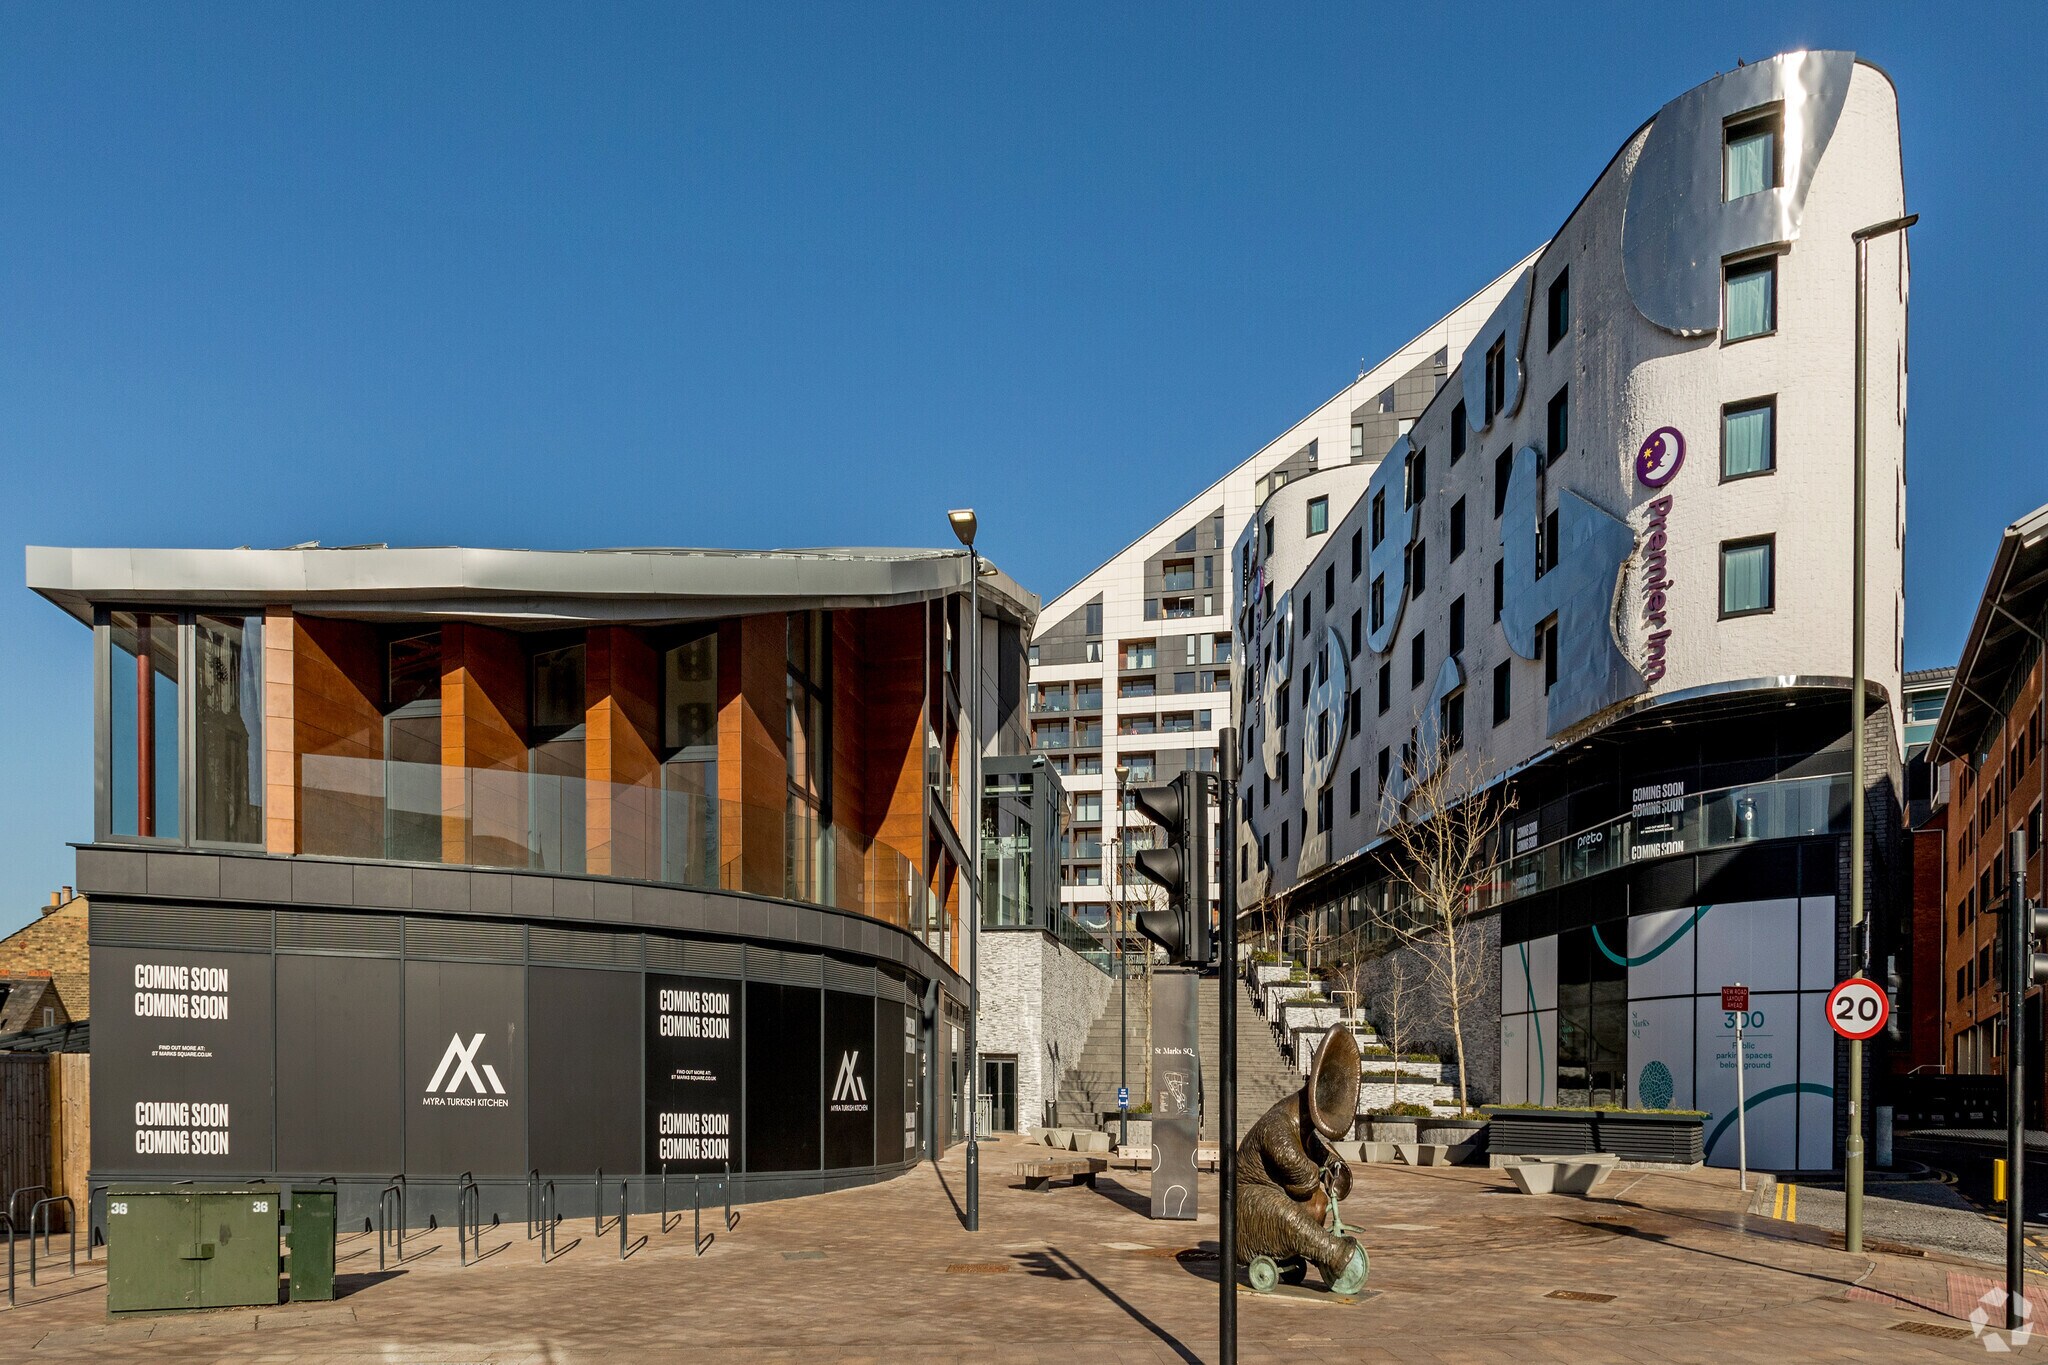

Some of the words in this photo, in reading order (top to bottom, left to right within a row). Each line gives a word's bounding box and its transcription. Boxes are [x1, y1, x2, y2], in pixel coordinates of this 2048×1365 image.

[1648, 494, 1674, 627] Premier
[1648, 628, 1672, 682] Inn
[1632, 784, 1661, 802] COMING
[1662, 781, 1684, 798] SOON
[1632, 801, 1661, 818] COMING
[1661, 797, 1684, 814] SOON
[1631, 843, 1661, 860] COMING
[1661, 840, 1684, 856] SOON
[135, 964, 189, 990] COMING
[190, 967, 229, 992] SOON
[135, 992, 189, 1018] COMING
[190, 995, 229, 1020] SOON
[660, 989, 700, 1013] COMING
[701, 992, 730, 1015] SOON
[1836, 996, 1878, 1021] 20
[660, 1014, 700, 1038] COMING
[701, 1017, 730, 1039] SOON
[1724, 1011, 1765, 1028] 300
[1163, 1046, 1182, 1055] Marks
[1182, 1047, 1196, 1058] SQ
[1731, 1041, 1756, 1050] Pblic
[1719, 1061, 1739, 1069] belo
[1744, 1061, 1771, 1070] ground
[1745, 1053, 1773, 1061] spaces
[422, 1097, 446, 1106] MYRA
[447, 1098, 476, 1106] TURKISH
[477, 1098, 509, 1107] KITCHEN
[135, 1101, 189, 1126] COMING
[191, 1103, 229, 1127] SOON
[659, 1112, 700, 1134] COMING
[701, 1113, 729, 1135] SOON
[135, 1129, 189, 1154] COMING
[191, 1130, 229, 1155] SOON
[659, 1137, 700, 1160] COMING
[701, 1138, 729, 1160] SOON
[110, 1202, 128, 1215] 36
[252, 1201, 269, 1213] 36
